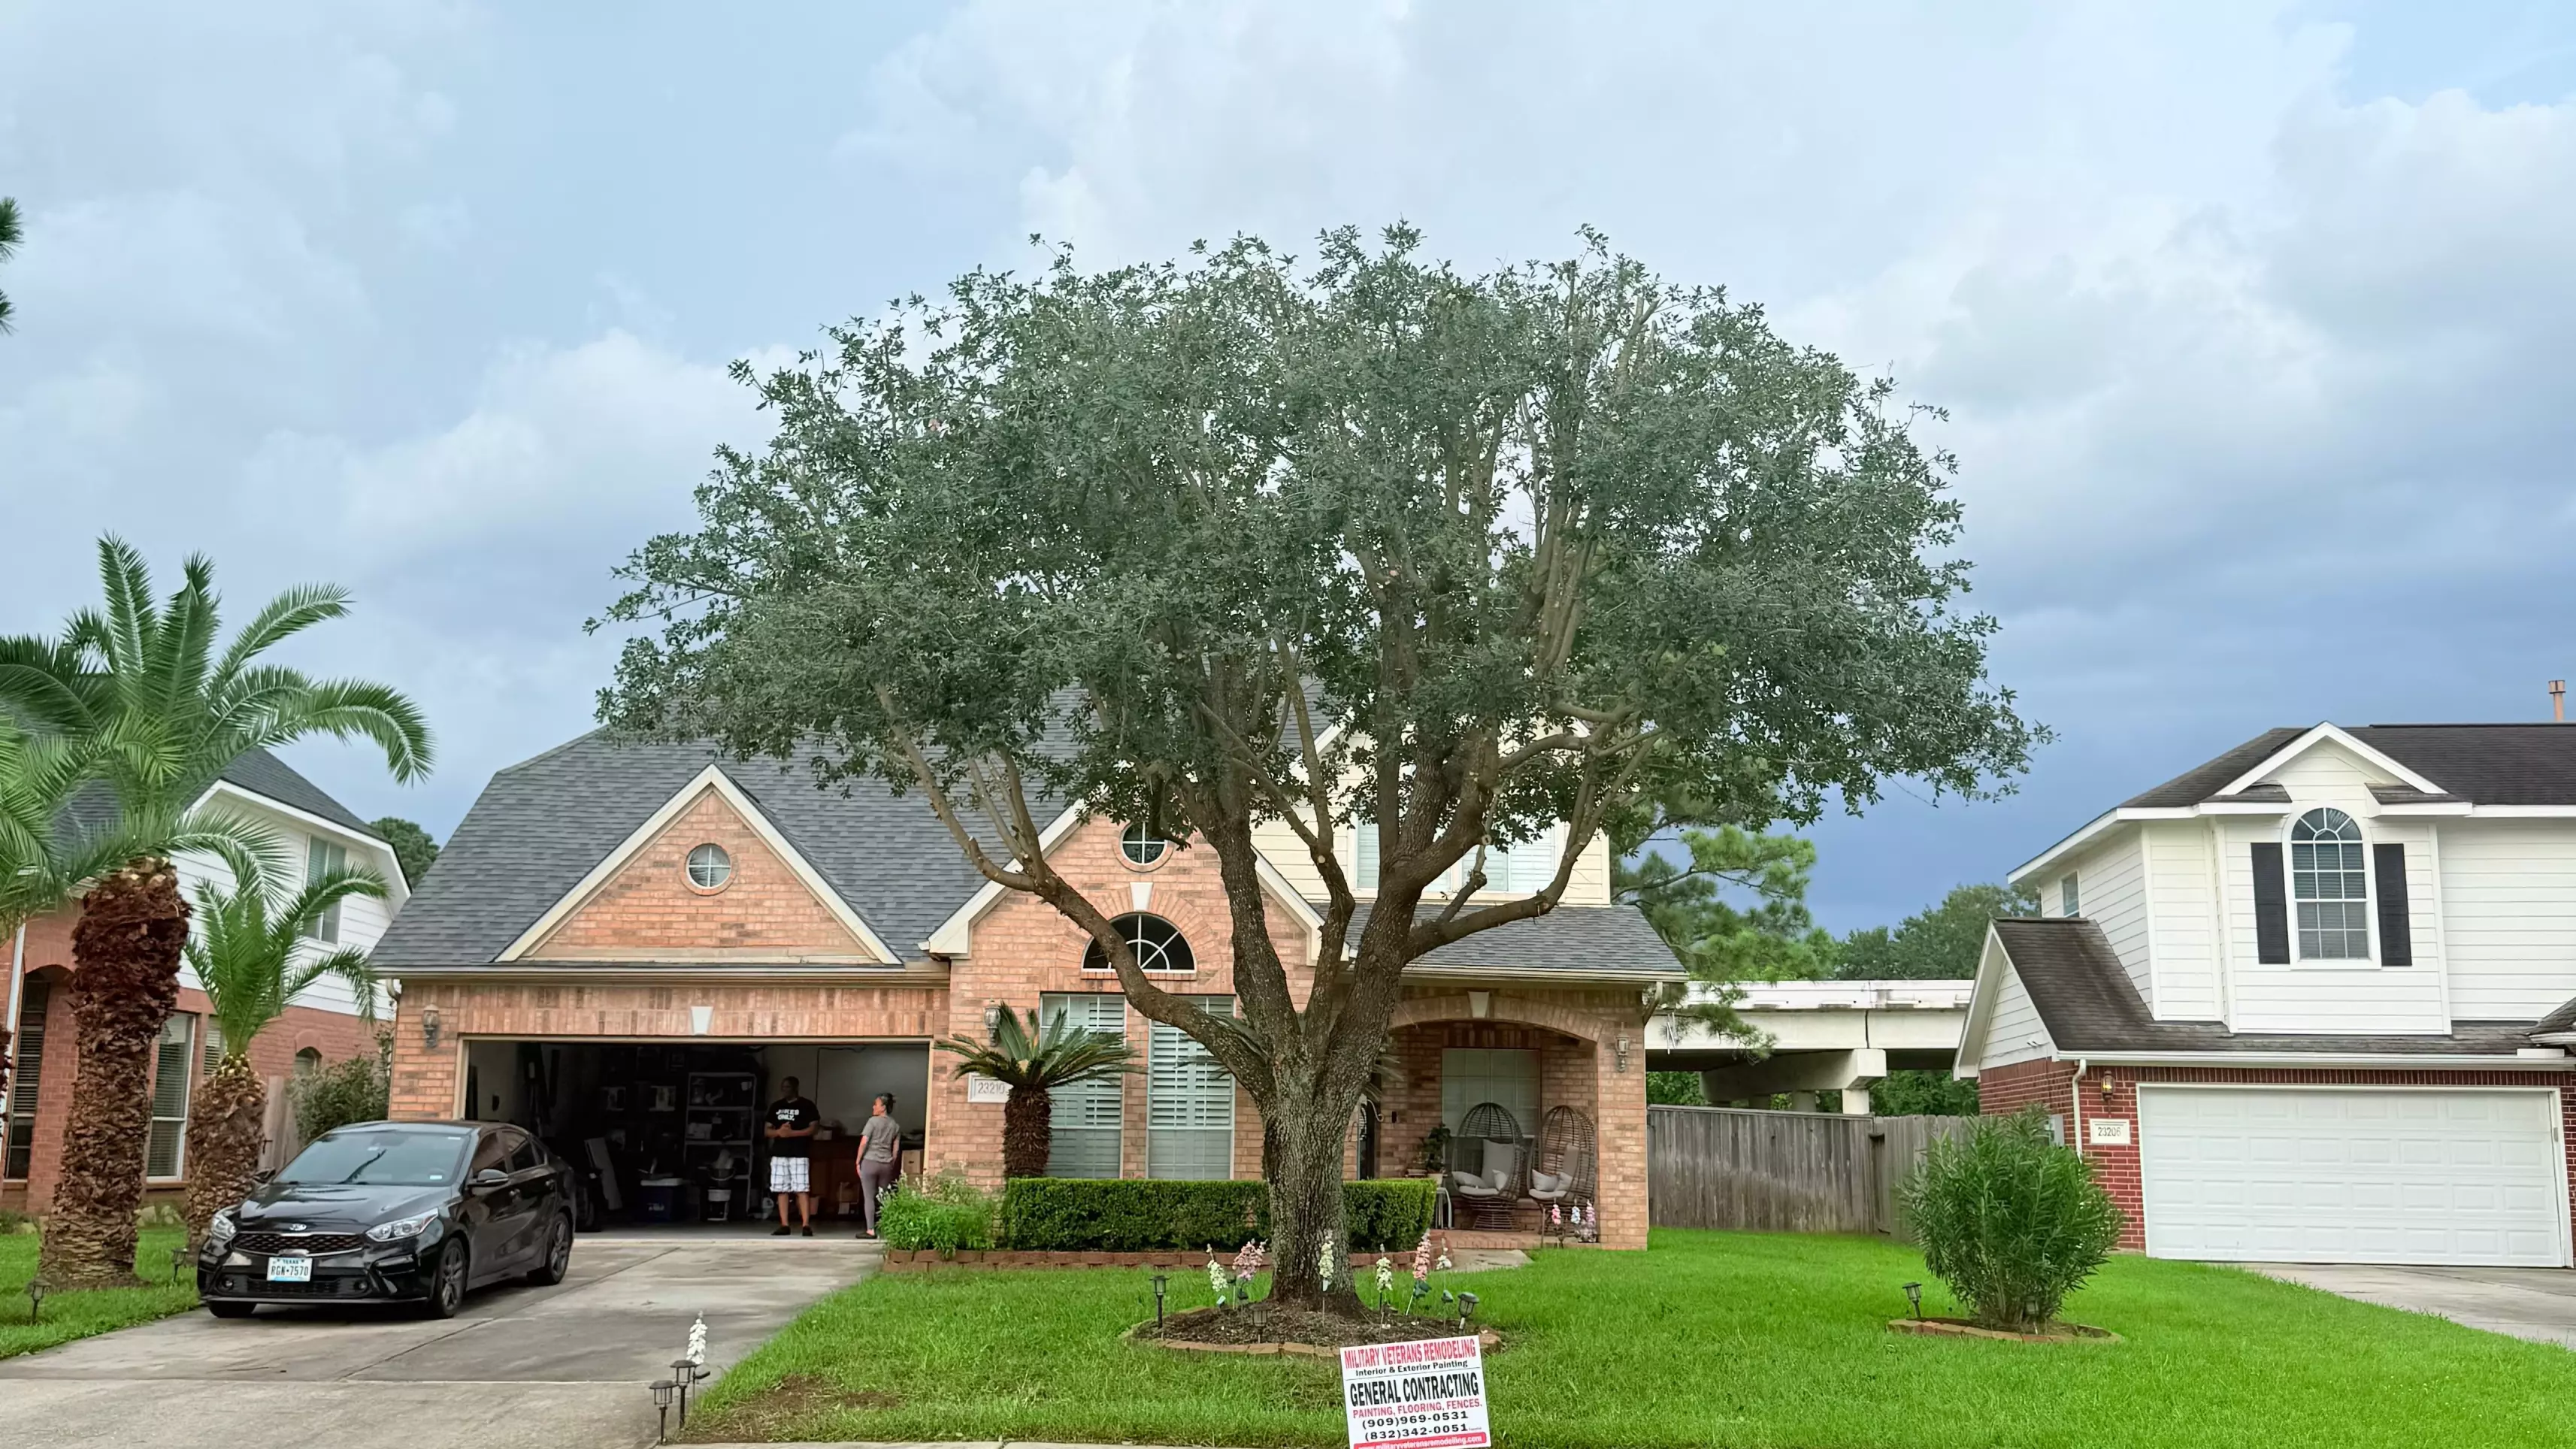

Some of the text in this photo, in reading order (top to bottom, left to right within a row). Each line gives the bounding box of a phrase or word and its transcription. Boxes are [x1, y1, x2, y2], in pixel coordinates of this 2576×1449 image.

[1344, 1339, 1476, 1369] MILITARY VETERANS REMODELING
[1355, 1368, 1386, 1377] Interior
[1397, 1364, 1430, 1372] Exterior
[1433, 1360, 1468, 1369] Painting
[1350, 1372, 1479, 1407] GENERAL CONTRACTING
[1353, 1399, 1482, 1418] PAINTING, FLOORING, FENCES.
[1362, 1411, 1468, 1429] (909)969-0531
[1365, 1423, 1467, 1441] (832)342-0051
